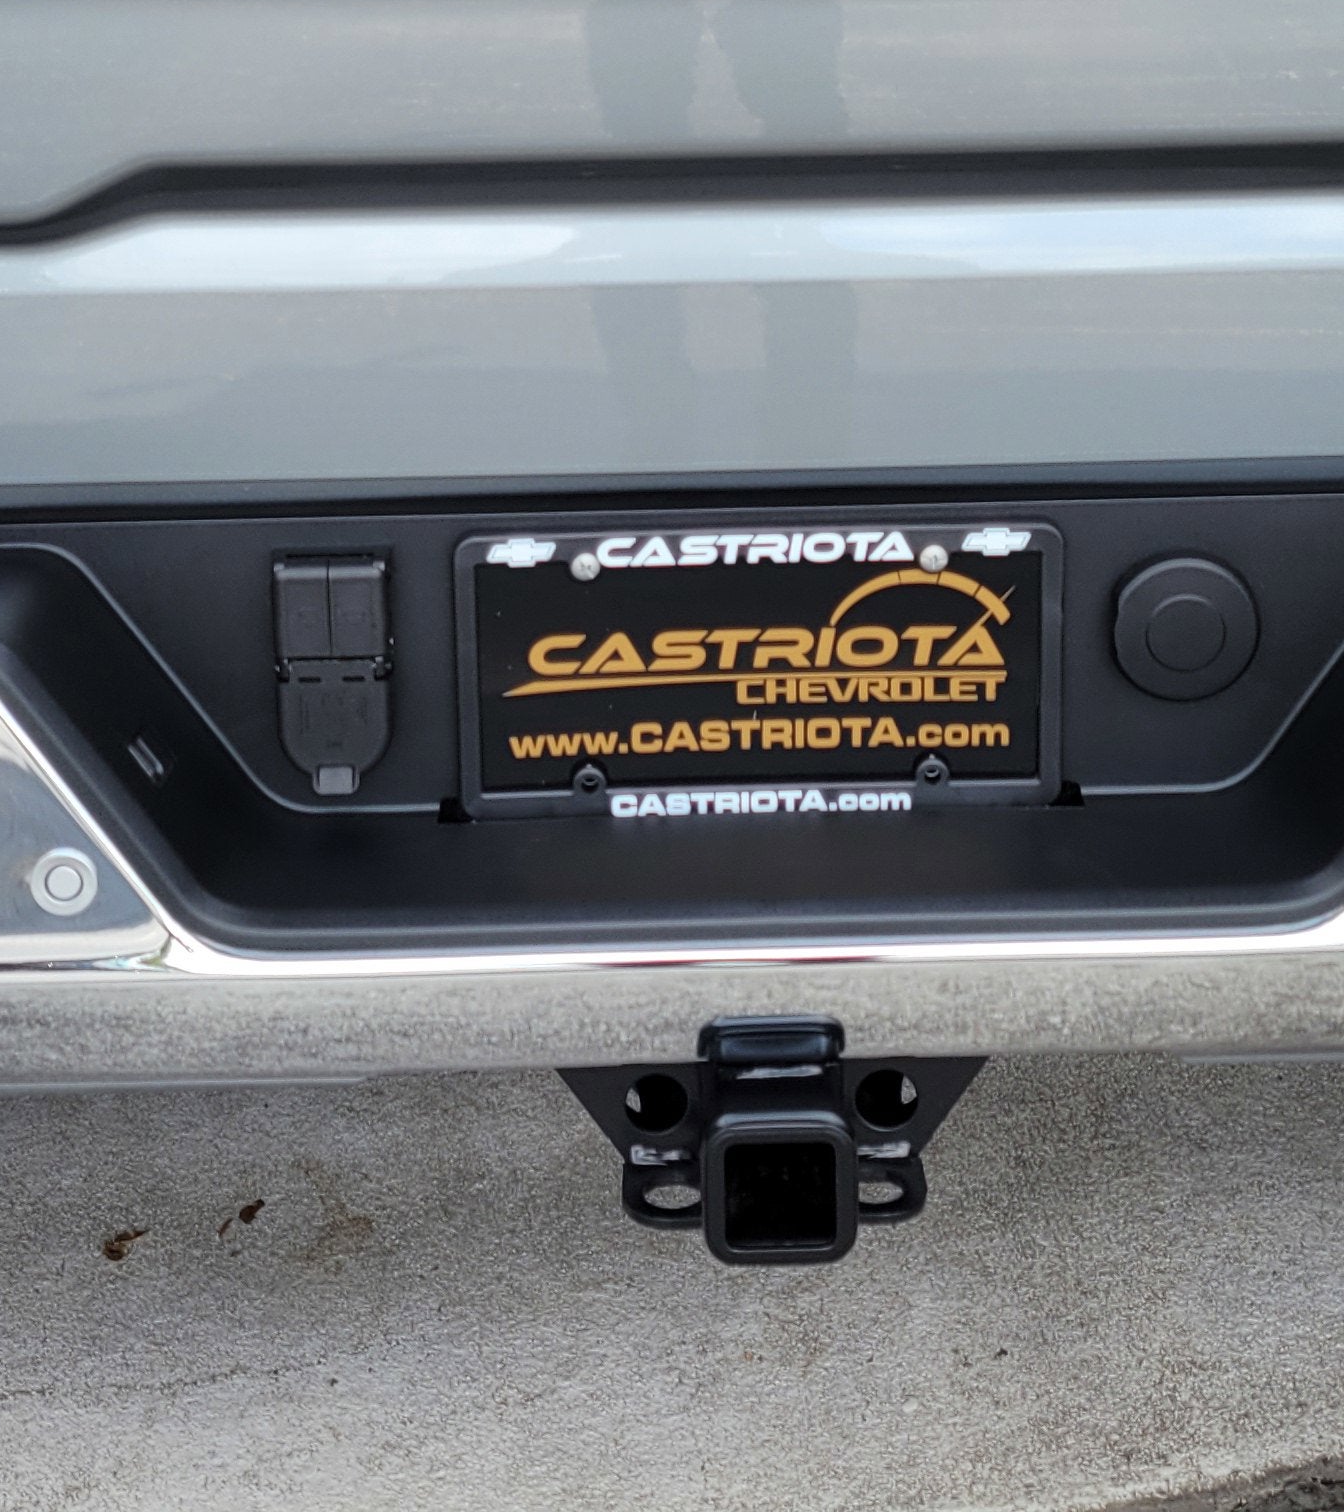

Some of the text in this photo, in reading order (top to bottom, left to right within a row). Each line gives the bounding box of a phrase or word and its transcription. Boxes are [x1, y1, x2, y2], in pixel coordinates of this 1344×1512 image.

[597, 531, 914, 567] CASTRIOTA
[527, 625, 1006, 675] CASTRIOTA
[736, 676, 1003, 705] CHEVROLET
[509, 717, 1010, 758] www.CASTRIOTA.com
[610, 789, 912, 818] CASTRIOTA.com
